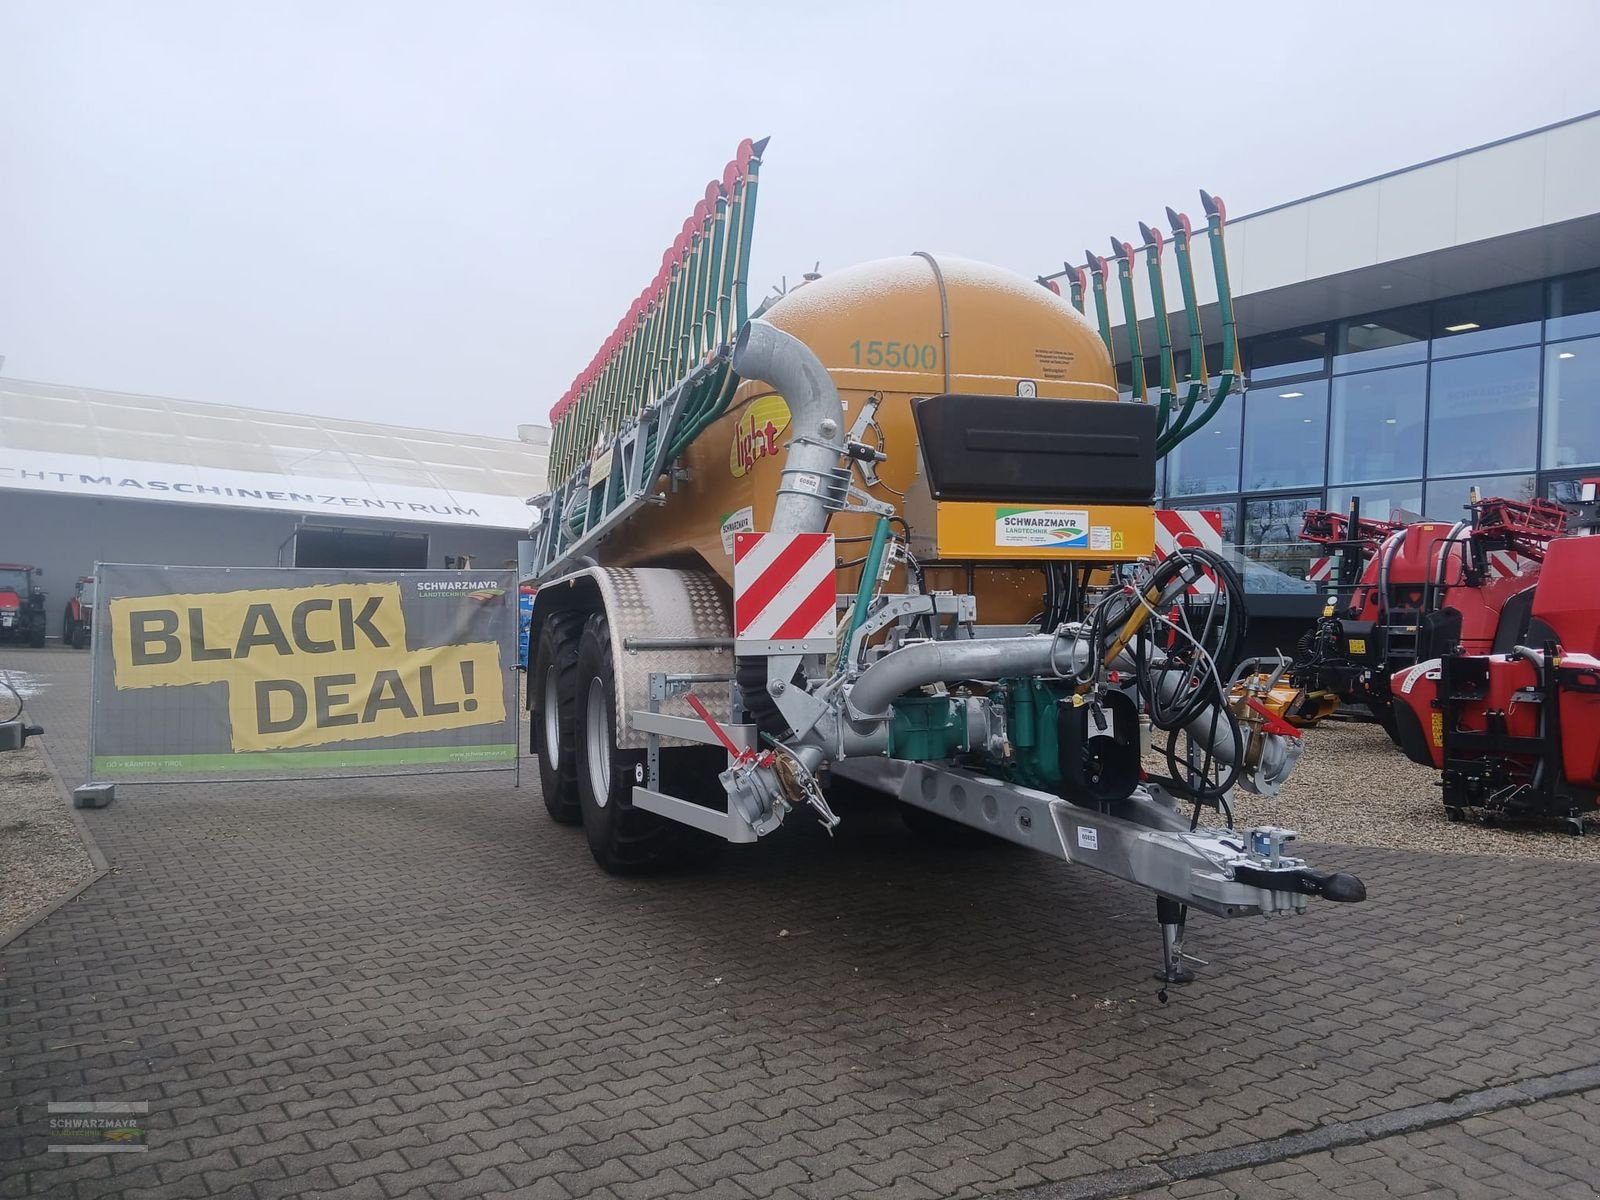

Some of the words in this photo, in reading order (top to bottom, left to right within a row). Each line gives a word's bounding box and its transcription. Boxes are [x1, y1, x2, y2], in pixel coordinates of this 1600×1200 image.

[849, 339, 937, 369] 15500
[735, 414, 779, 475] light
[1004, 517, 1077, 528] SCHWARZMAYR
[1005, 527, 1048, 535] LANDTECHNIK
[417, 581, 497, 591] SCHWARZMAYR
[129, 596, 391, 667] BLACK
[254, 660, 479, 735] DEAL!
